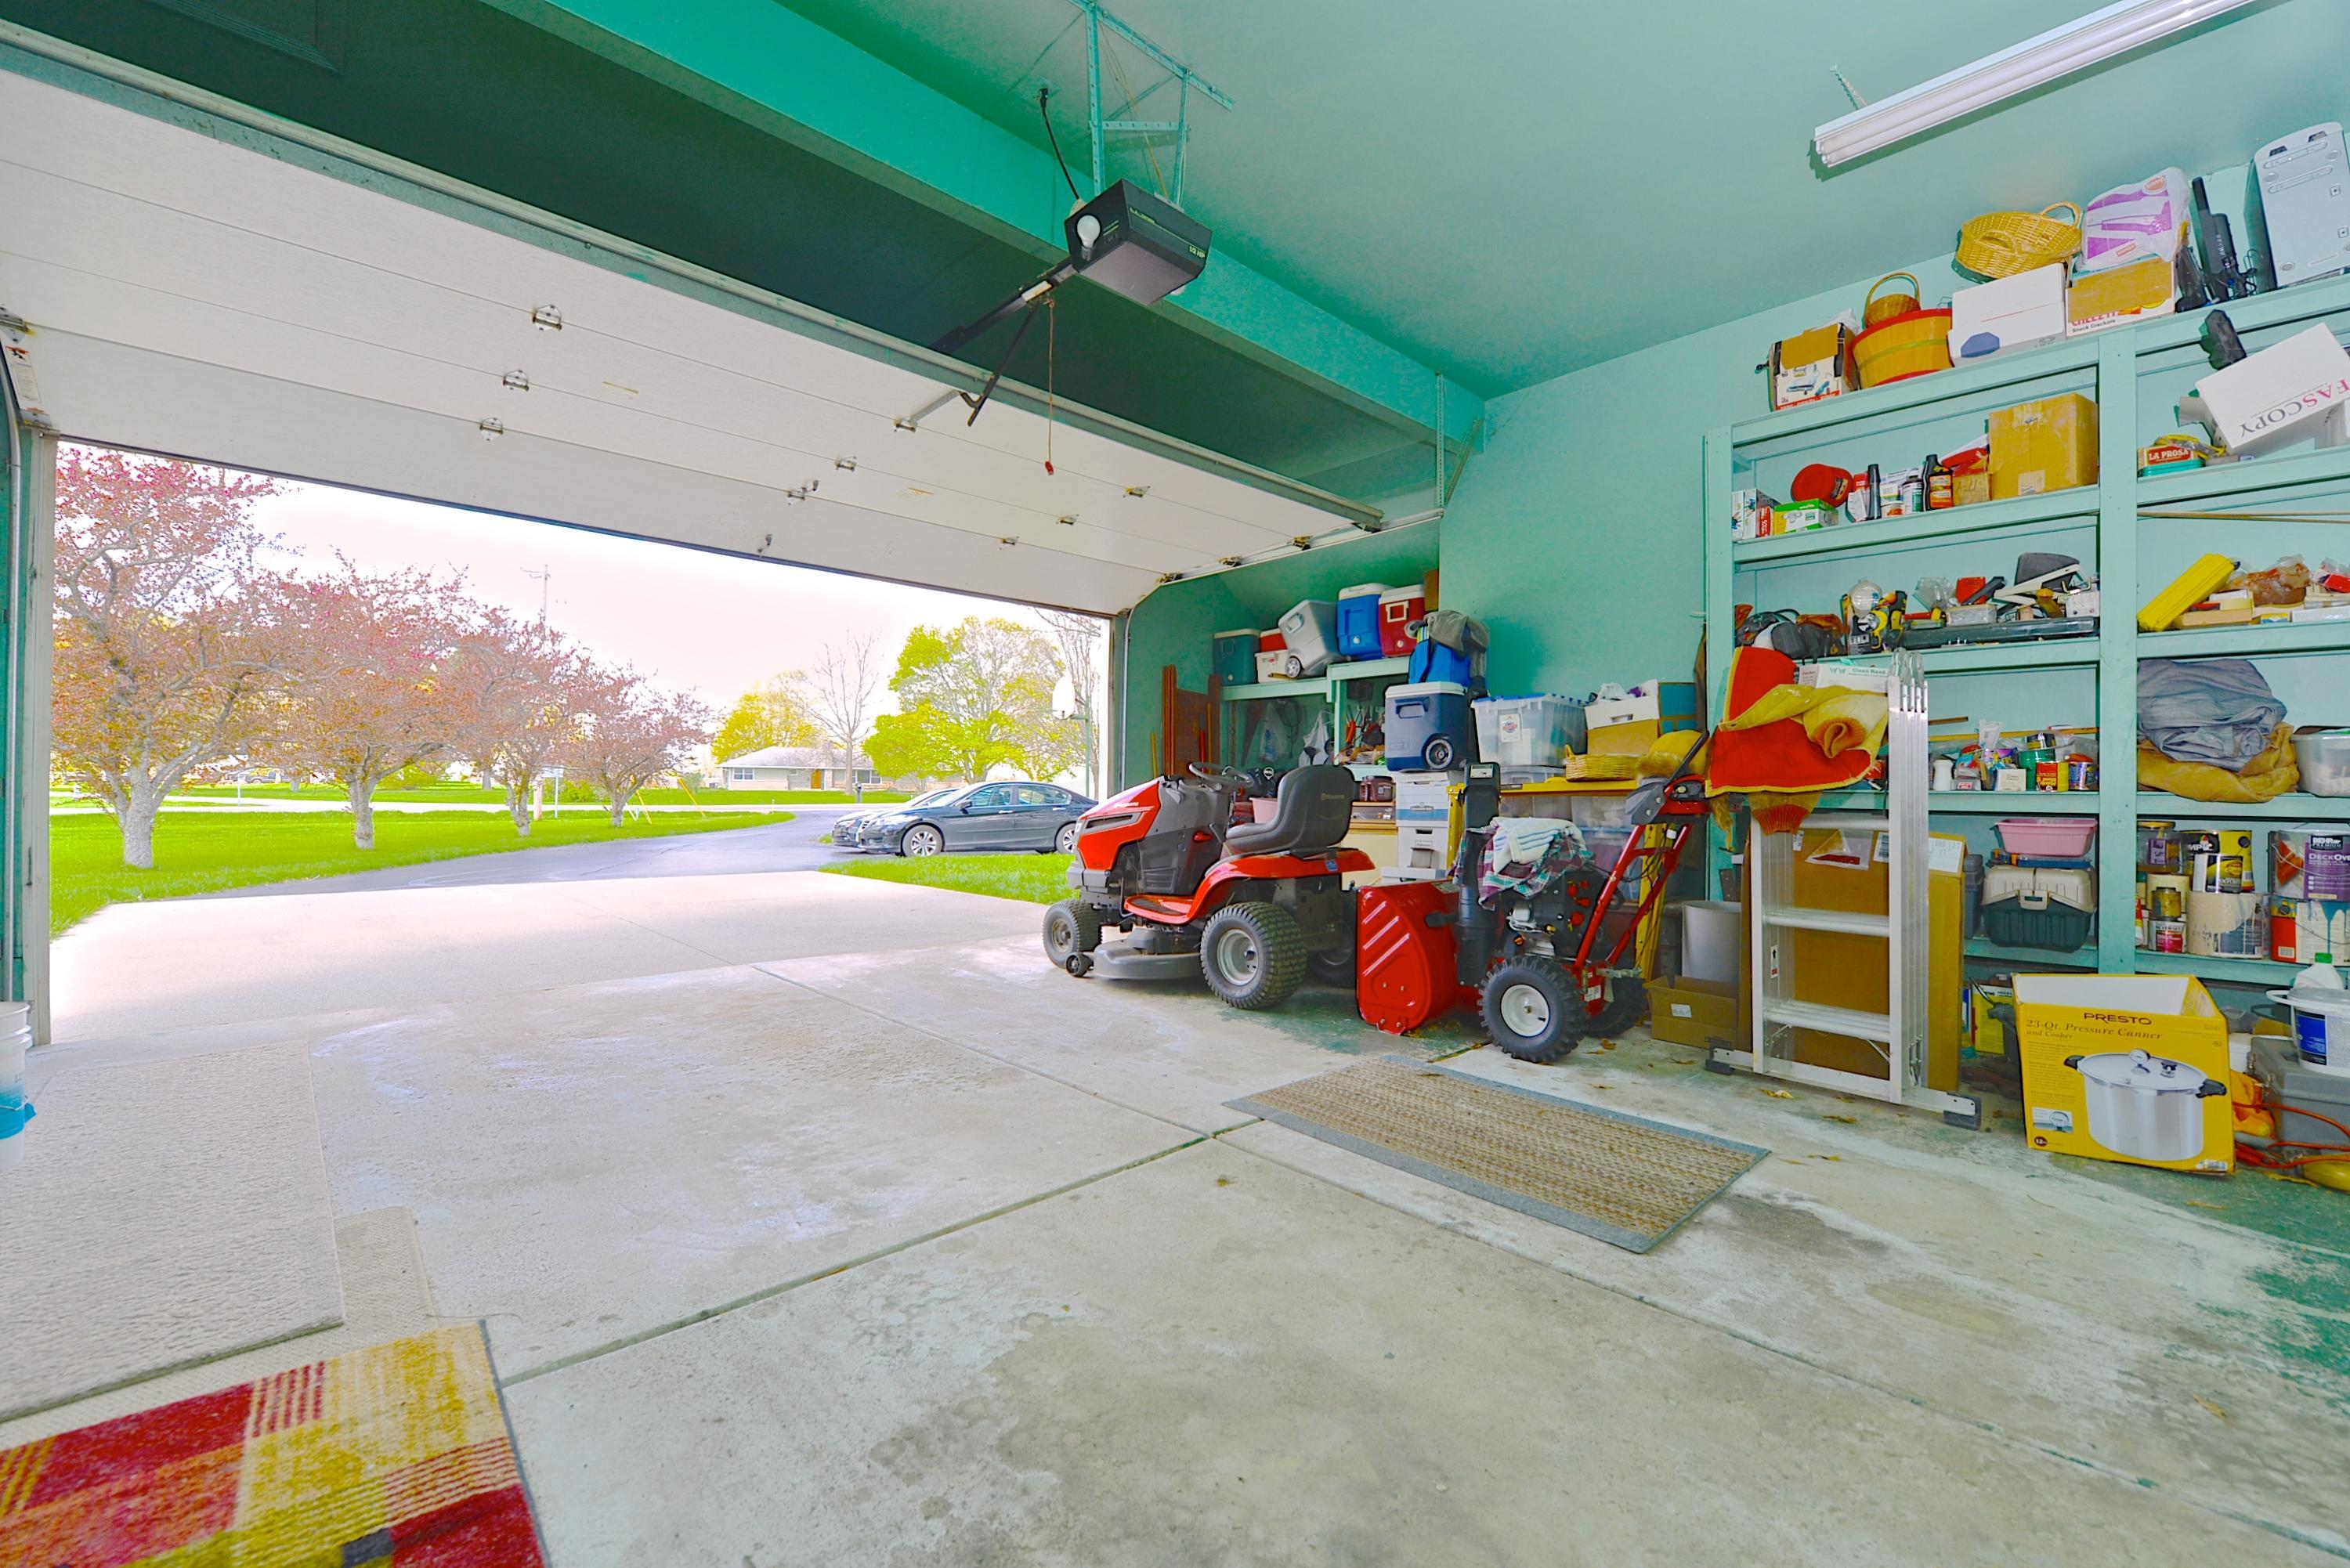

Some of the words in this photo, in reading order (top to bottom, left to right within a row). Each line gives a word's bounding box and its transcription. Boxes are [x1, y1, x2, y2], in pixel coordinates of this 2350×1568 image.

[2090, 319, 2116, 329] Crackers
[2239, 378, 2350, 437] FASCOPY
[2149, 452, 2160, 461] LA
[2084, 1012, 2153, 1025] PRESTO
[2026, 1020, 2062, 1031] 23-Qt.
[2065, 1023, 2115, 1035] Pressure
[2117, 1028, 2164, 1039] Canner
[2044, 1031, 2074, 1039] Cooker
